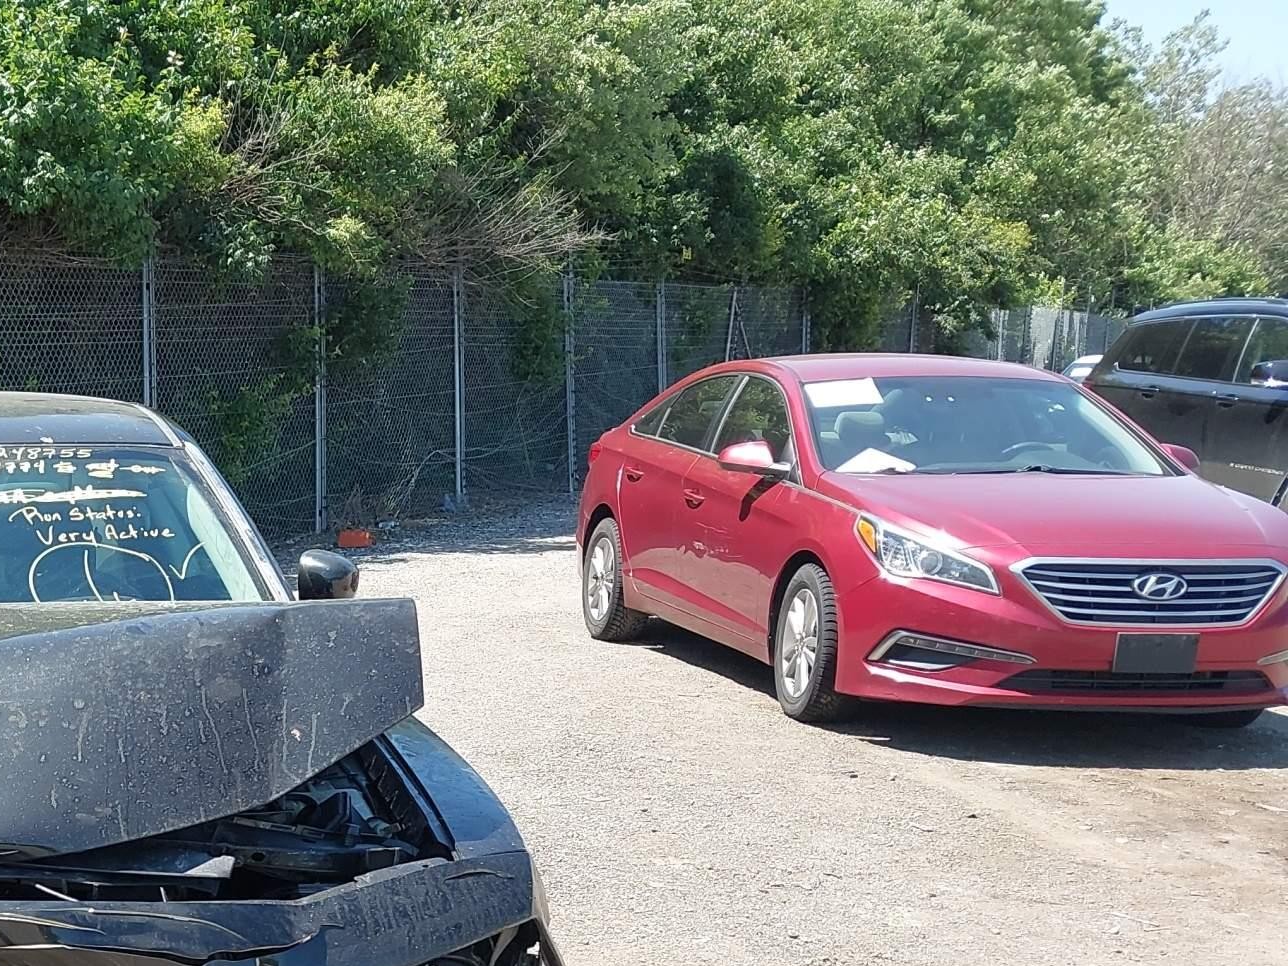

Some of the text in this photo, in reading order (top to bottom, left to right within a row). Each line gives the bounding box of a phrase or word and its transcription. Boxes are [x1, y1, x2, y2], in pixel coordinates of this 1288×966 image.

[8, 506, 61, 526] Run
[36, 523, 176, 547] Very Active
